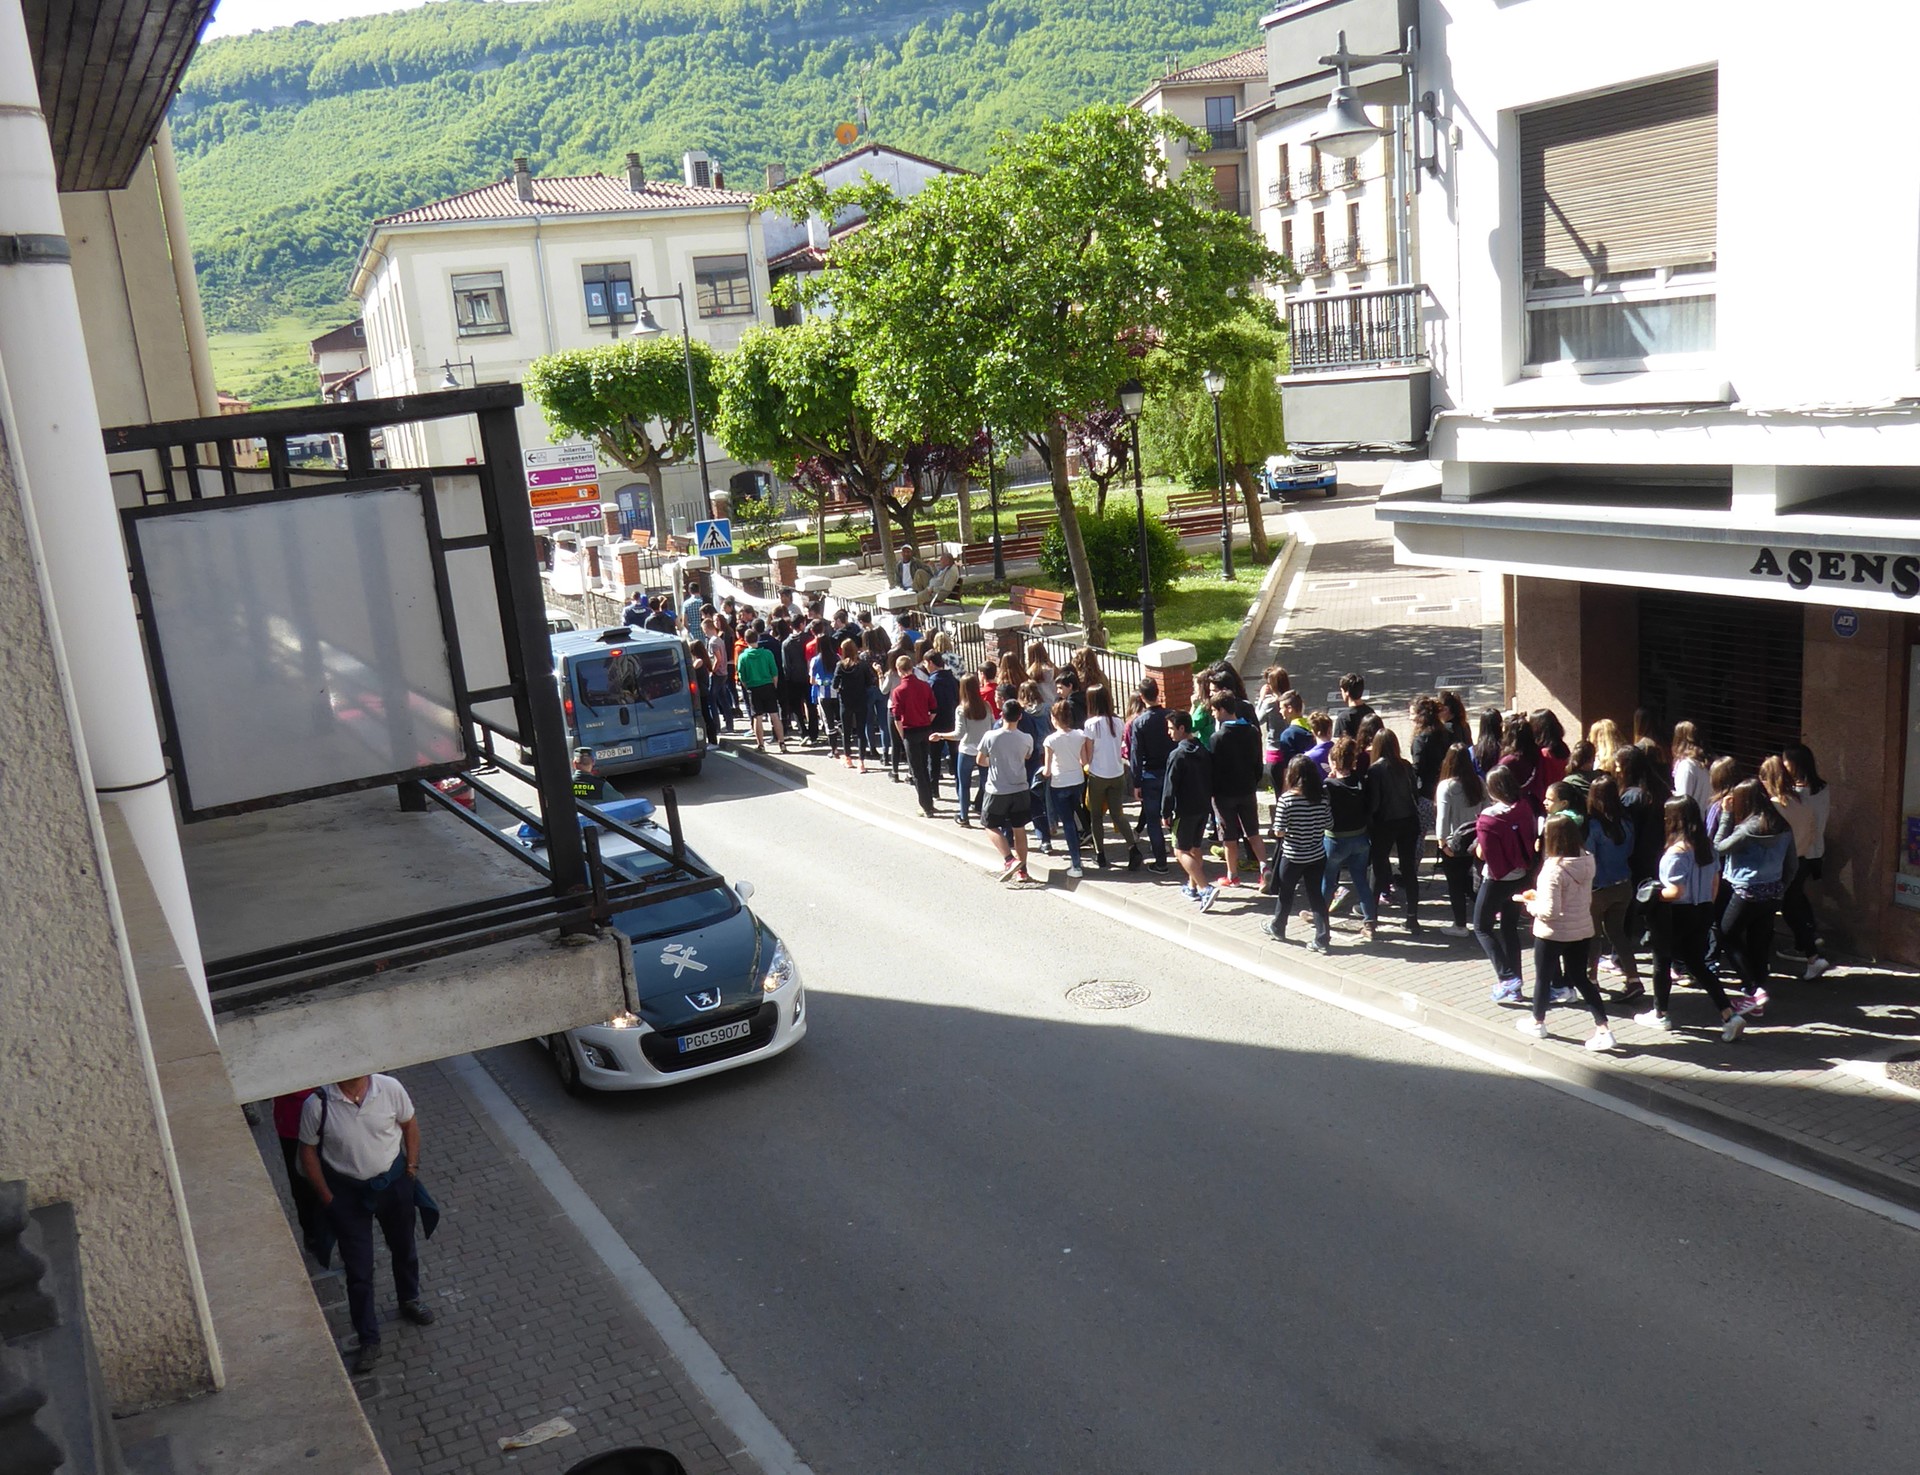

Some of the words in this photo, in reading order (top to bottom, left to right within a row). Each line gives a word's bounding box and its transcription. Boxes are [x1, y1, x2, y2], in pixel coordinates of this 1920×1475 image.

[1749, 547, 1920, 599] ASENS
[1837, 615, 1855, 627] ADT
[597, 748, 616, 759] 2708
